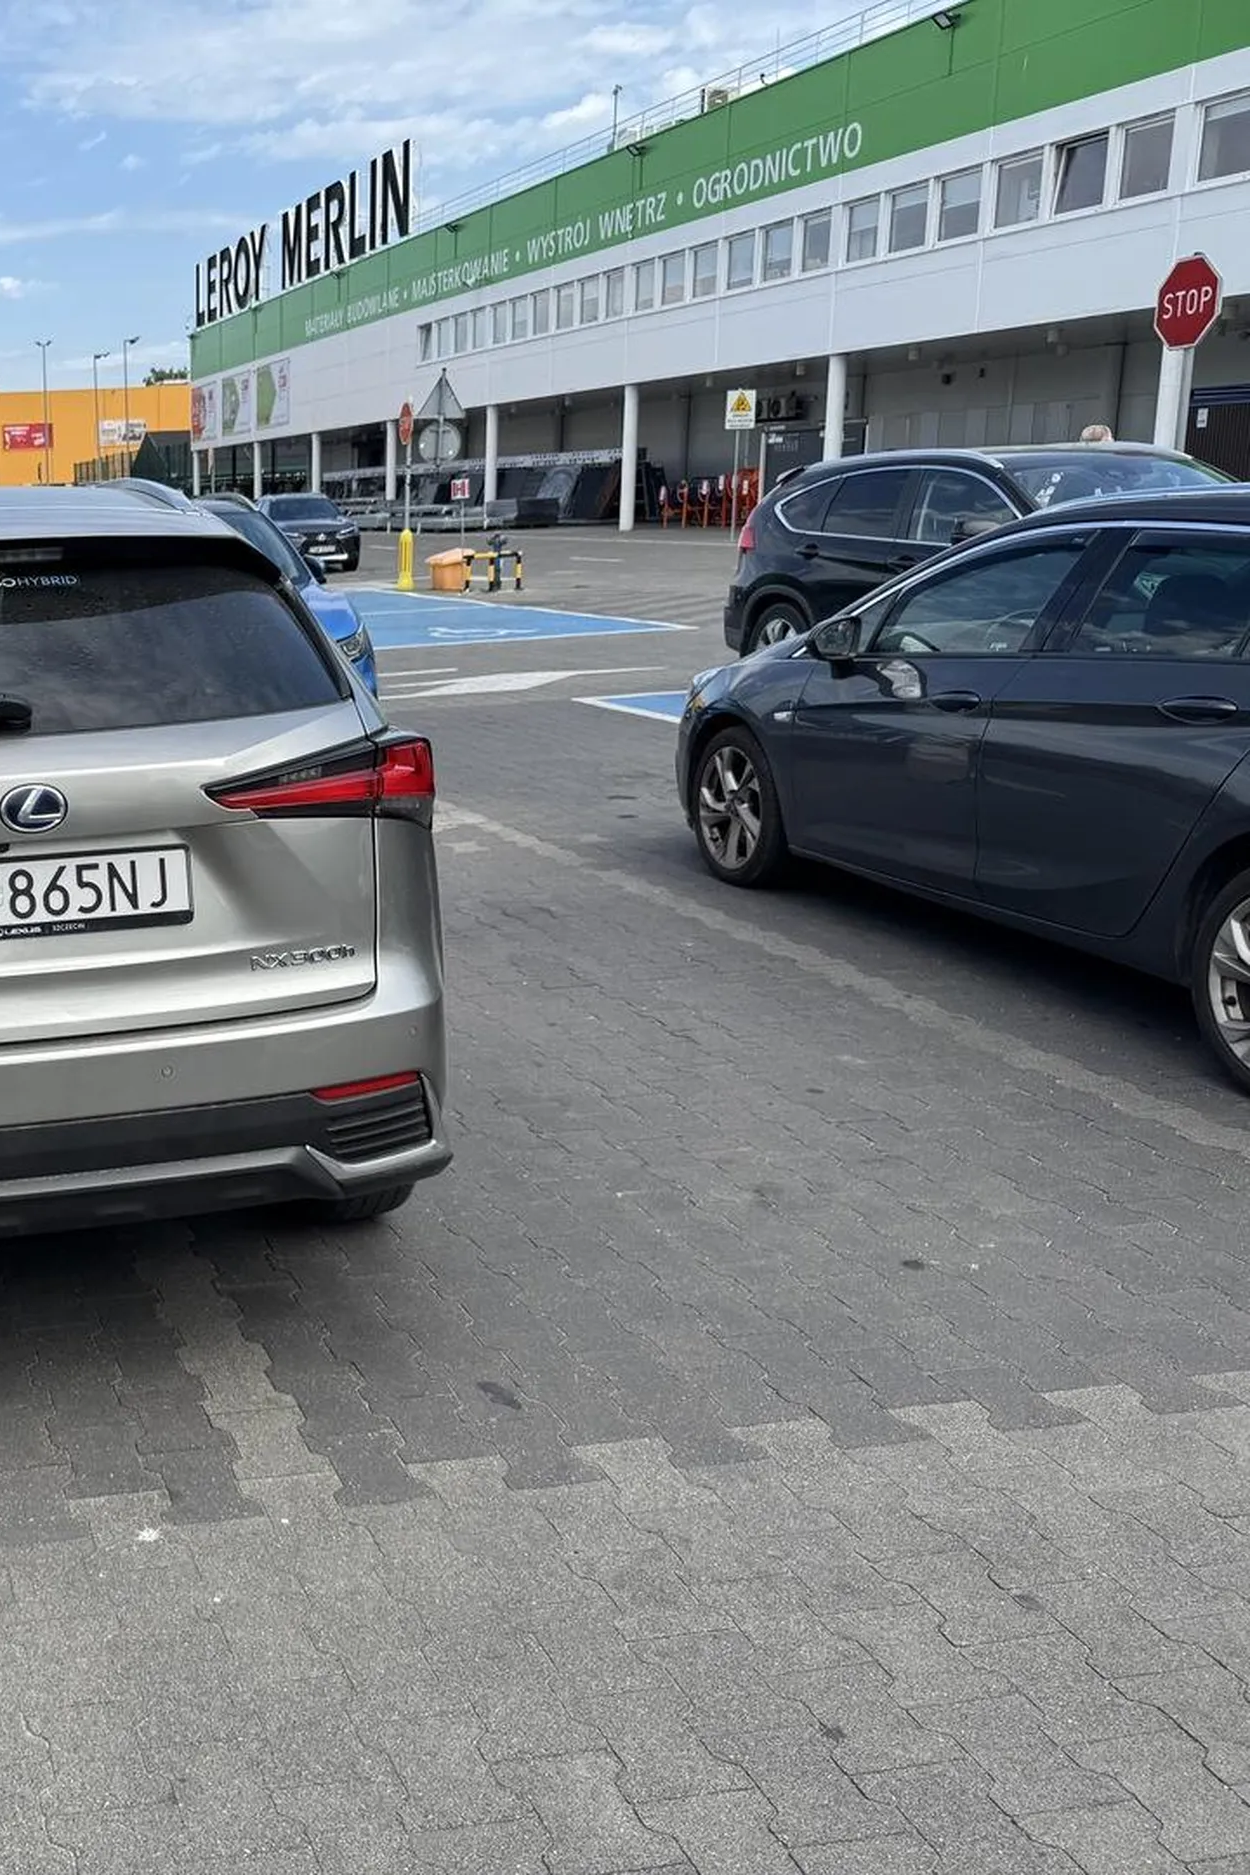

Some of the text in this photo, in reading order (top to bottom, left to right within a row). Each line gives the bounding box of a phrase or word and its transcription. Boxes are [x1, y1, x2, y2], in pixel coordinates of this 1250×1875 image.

[598, 191, 667, 239] WNĘTRZ
[692, 121, 862, 209] OGRODNICTWO
[195, 138, 411, 328] LEROY MERLIN
[1161, 285, 1213, 319] STOP
[8, 857, 169, 920] 865NJ
[4, 926, 42, 936] LEXUS
